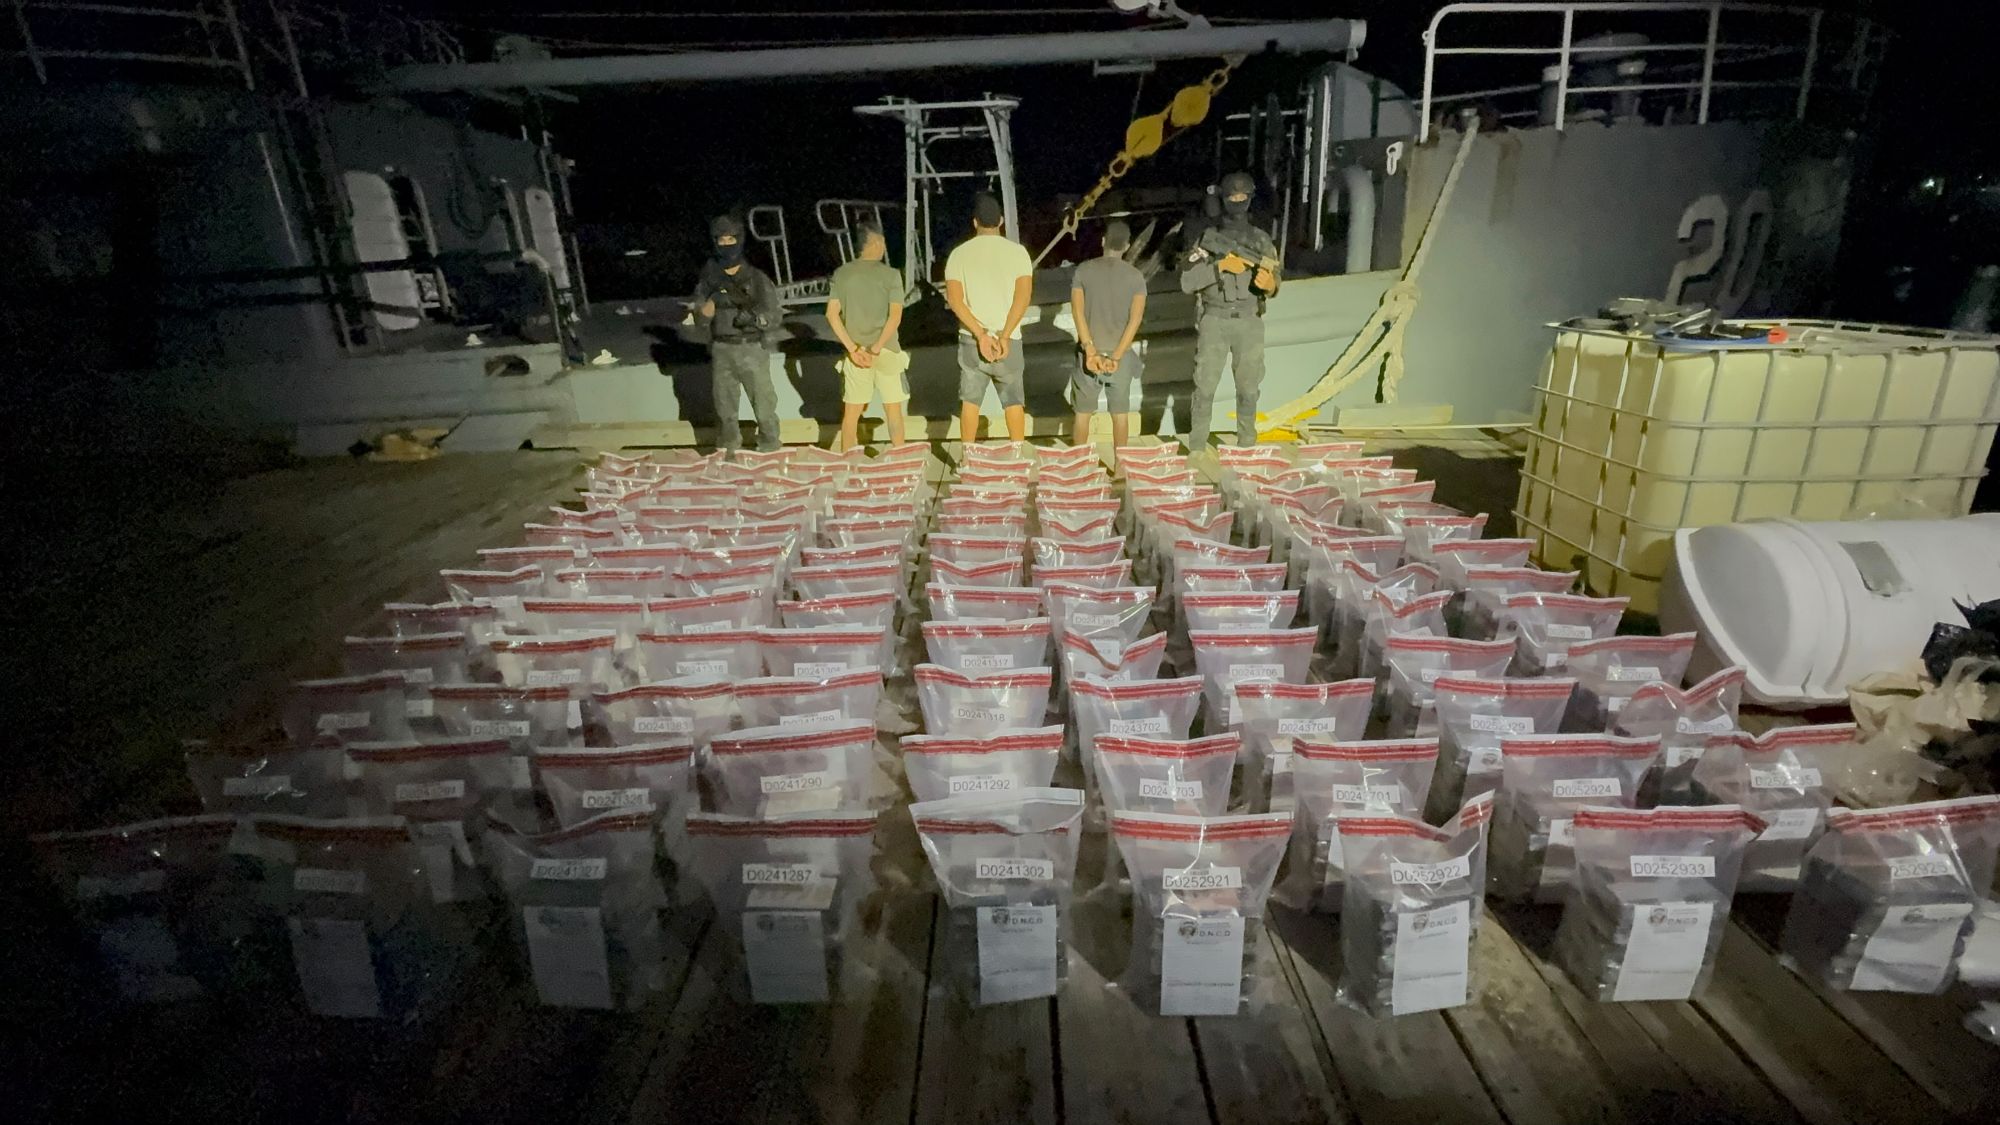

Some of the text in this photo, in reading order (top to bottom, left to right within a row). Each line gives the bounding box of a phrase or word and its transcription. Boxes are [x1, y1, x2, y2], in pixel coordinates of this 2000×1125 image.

[1112, 722, 1161, 733] D0243702
[1280, 723, 1329, 733] D0243704
[763, 776, 823, 791] D0241290
[952, 779, 1011, 792] D0241292
[1143, 785, 1195, 798] D024703
[1336, 785, 1391, 801] D024701
[1555, 785, 1612, 796] D0252924
[746, 869, 812, 881] D0241287
[980, 864, 1045, 878] D0241302
[1634, 862, 1706, 876] D0252933
[1164, 874, 1230, 888] D0252921
